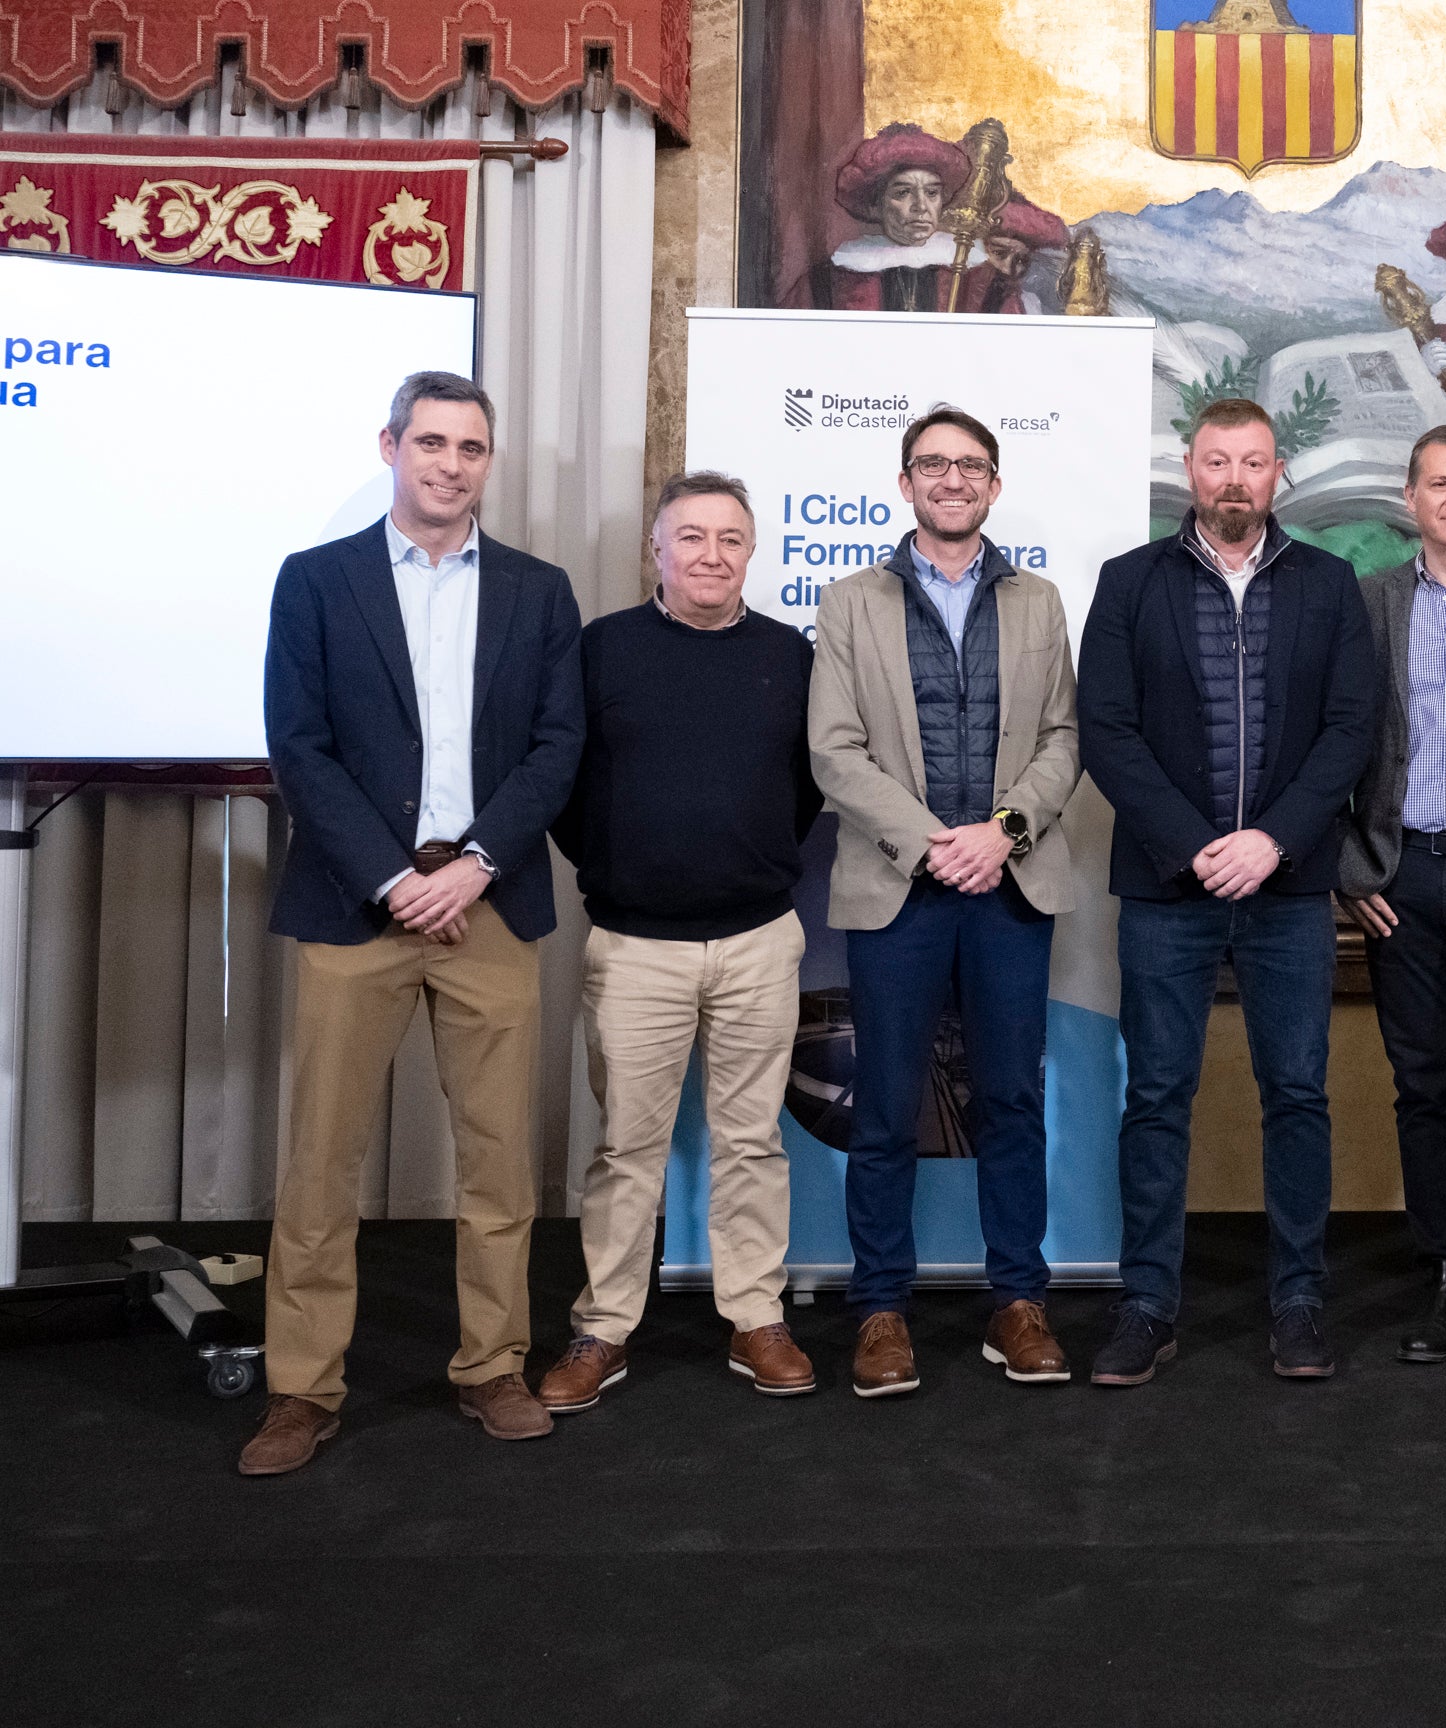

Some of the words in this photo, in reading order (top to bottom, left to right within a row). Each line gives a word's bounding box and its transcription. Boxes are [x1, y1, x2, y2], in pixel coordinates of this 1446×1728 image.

[5, 337, 111, 369] para
[821, 394, 909, 413] Diputació
[821, 413, 844, 428] de
[847, 413, 917, 429] Castelló
[784, 494, 791, 524] I
[800, 493, 891, 526] Ciclo
[783, 535, 896, 566] Forma
[997, 545, 1047, 569] ara
